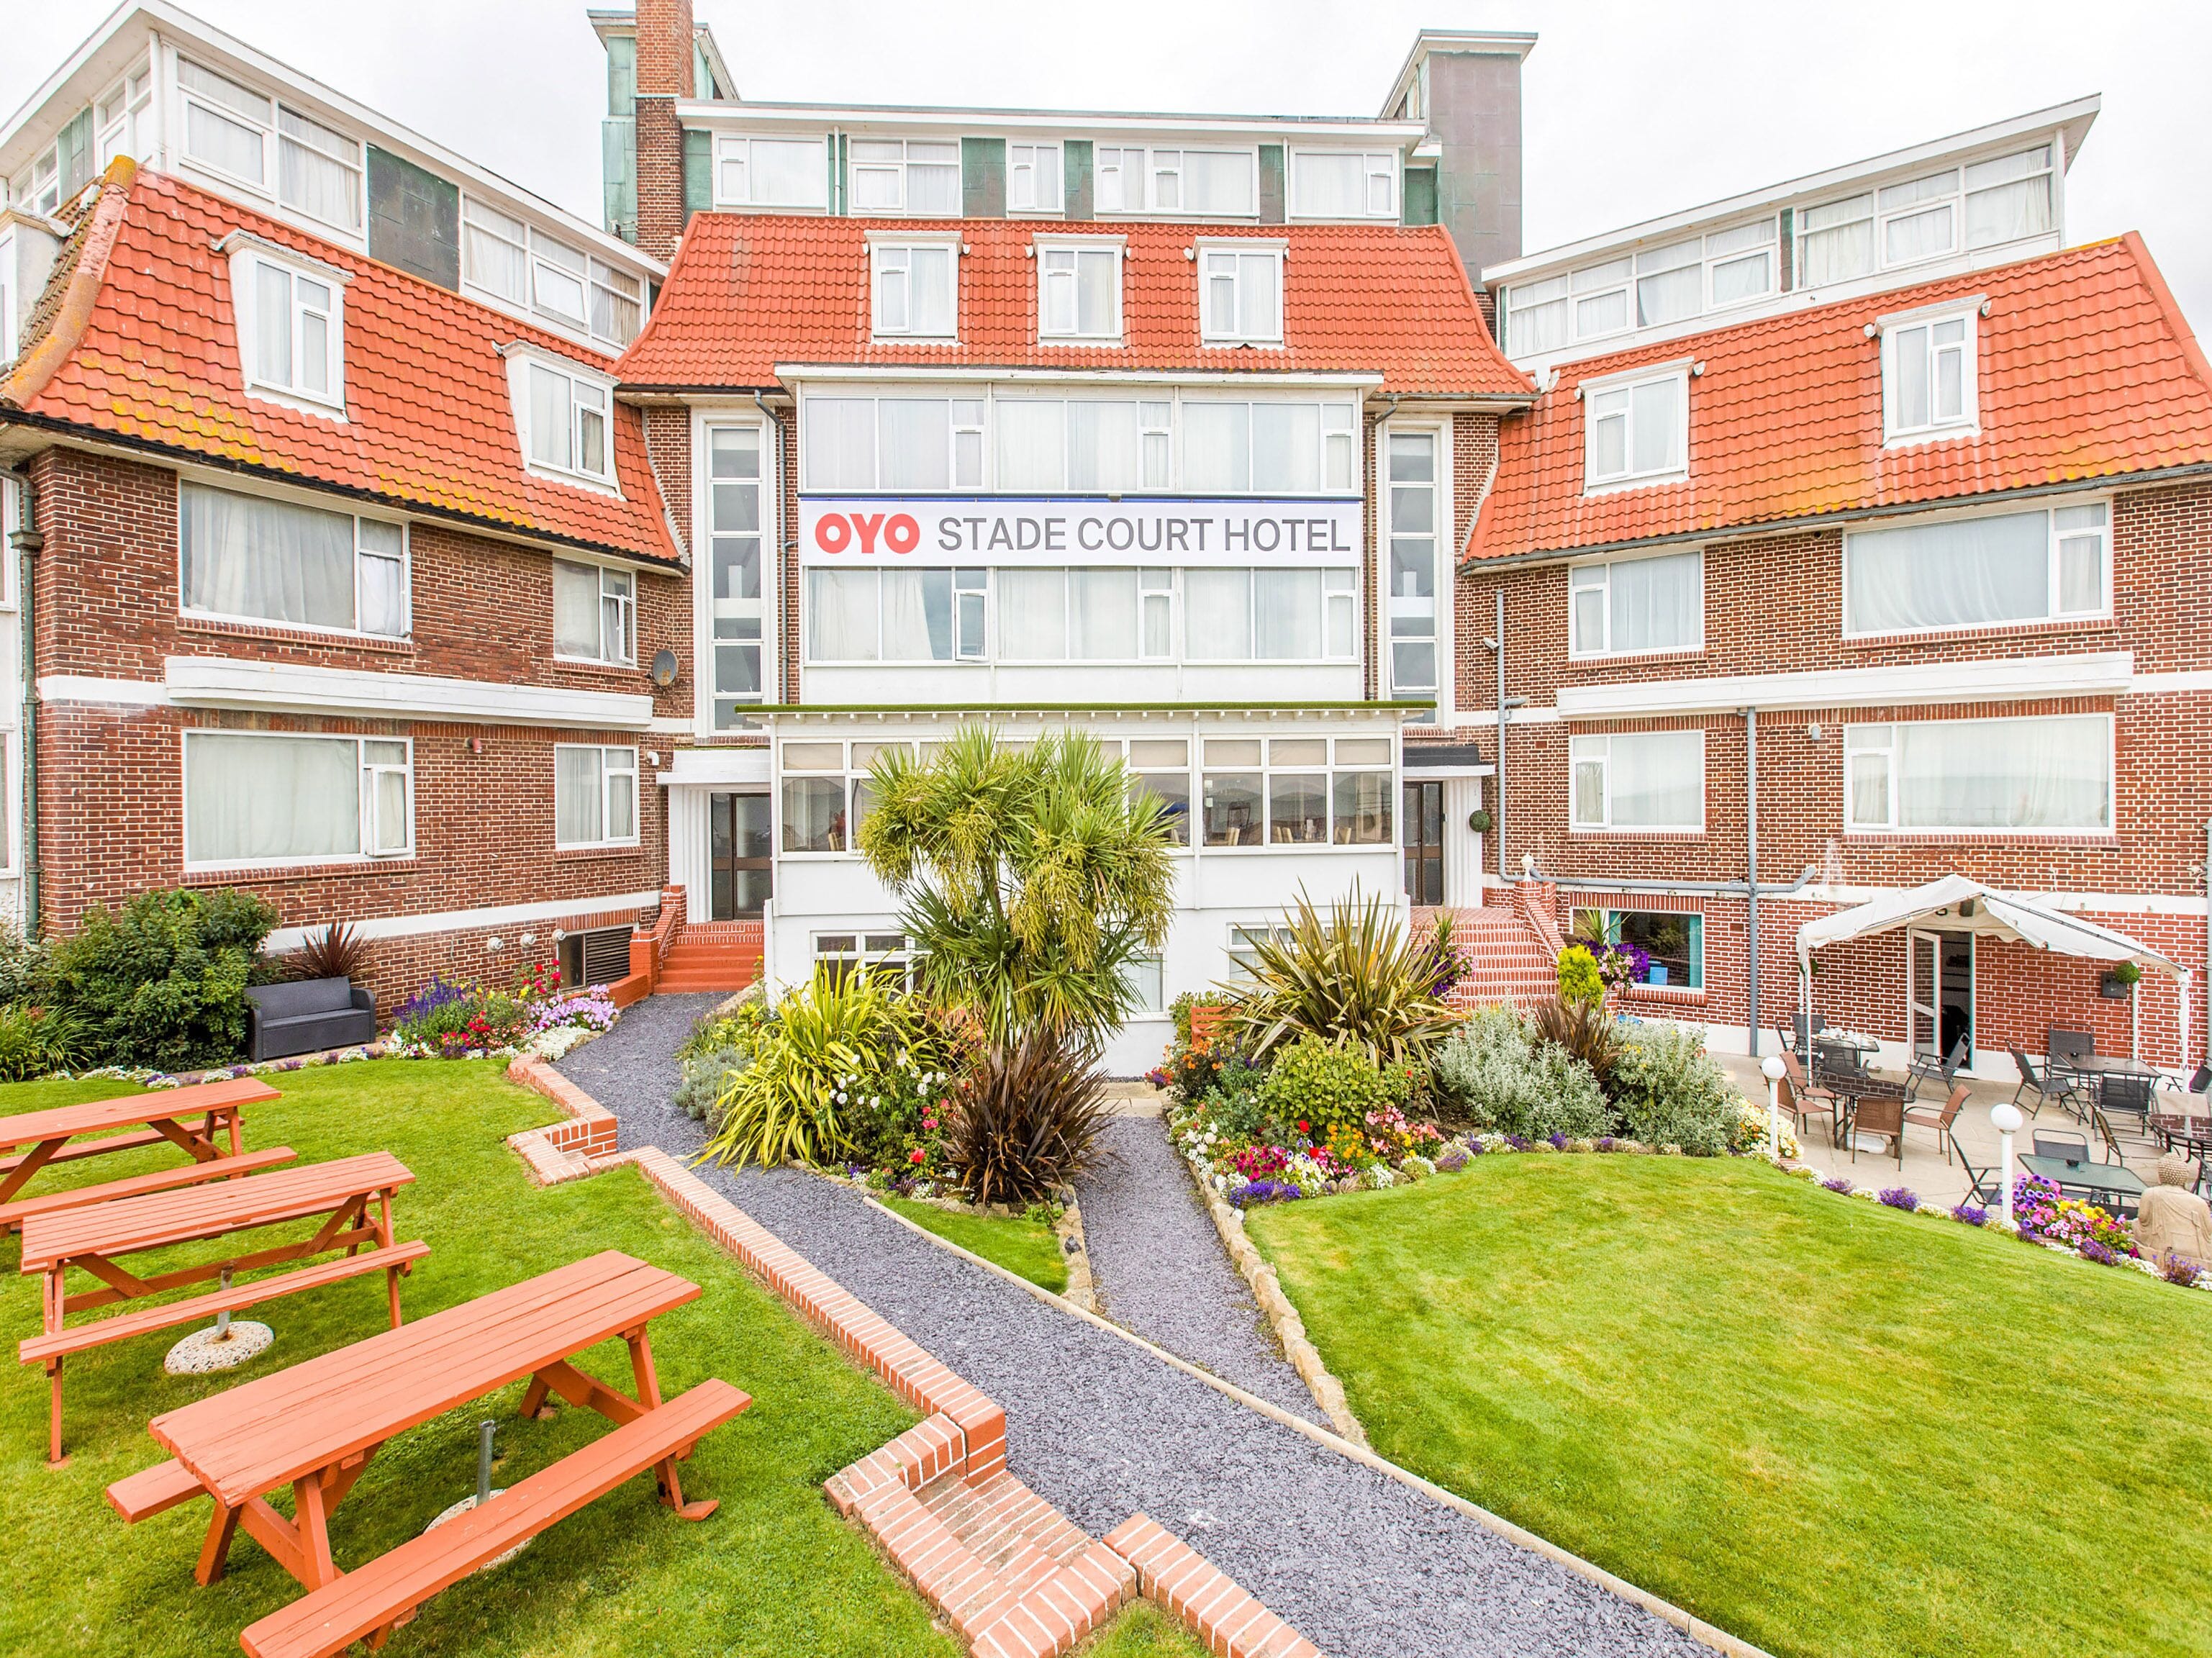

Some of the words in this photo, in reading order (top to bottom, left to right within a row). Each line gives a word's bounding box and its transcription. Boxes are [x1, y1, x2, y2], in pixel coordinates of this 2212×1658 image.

[815, 513, 920, 554] OYO
[938, 517, 1066, 551] STADE
[1077, 517, 1214, 551] COURT
[1225, 519, 1351, 552] HOTEL
